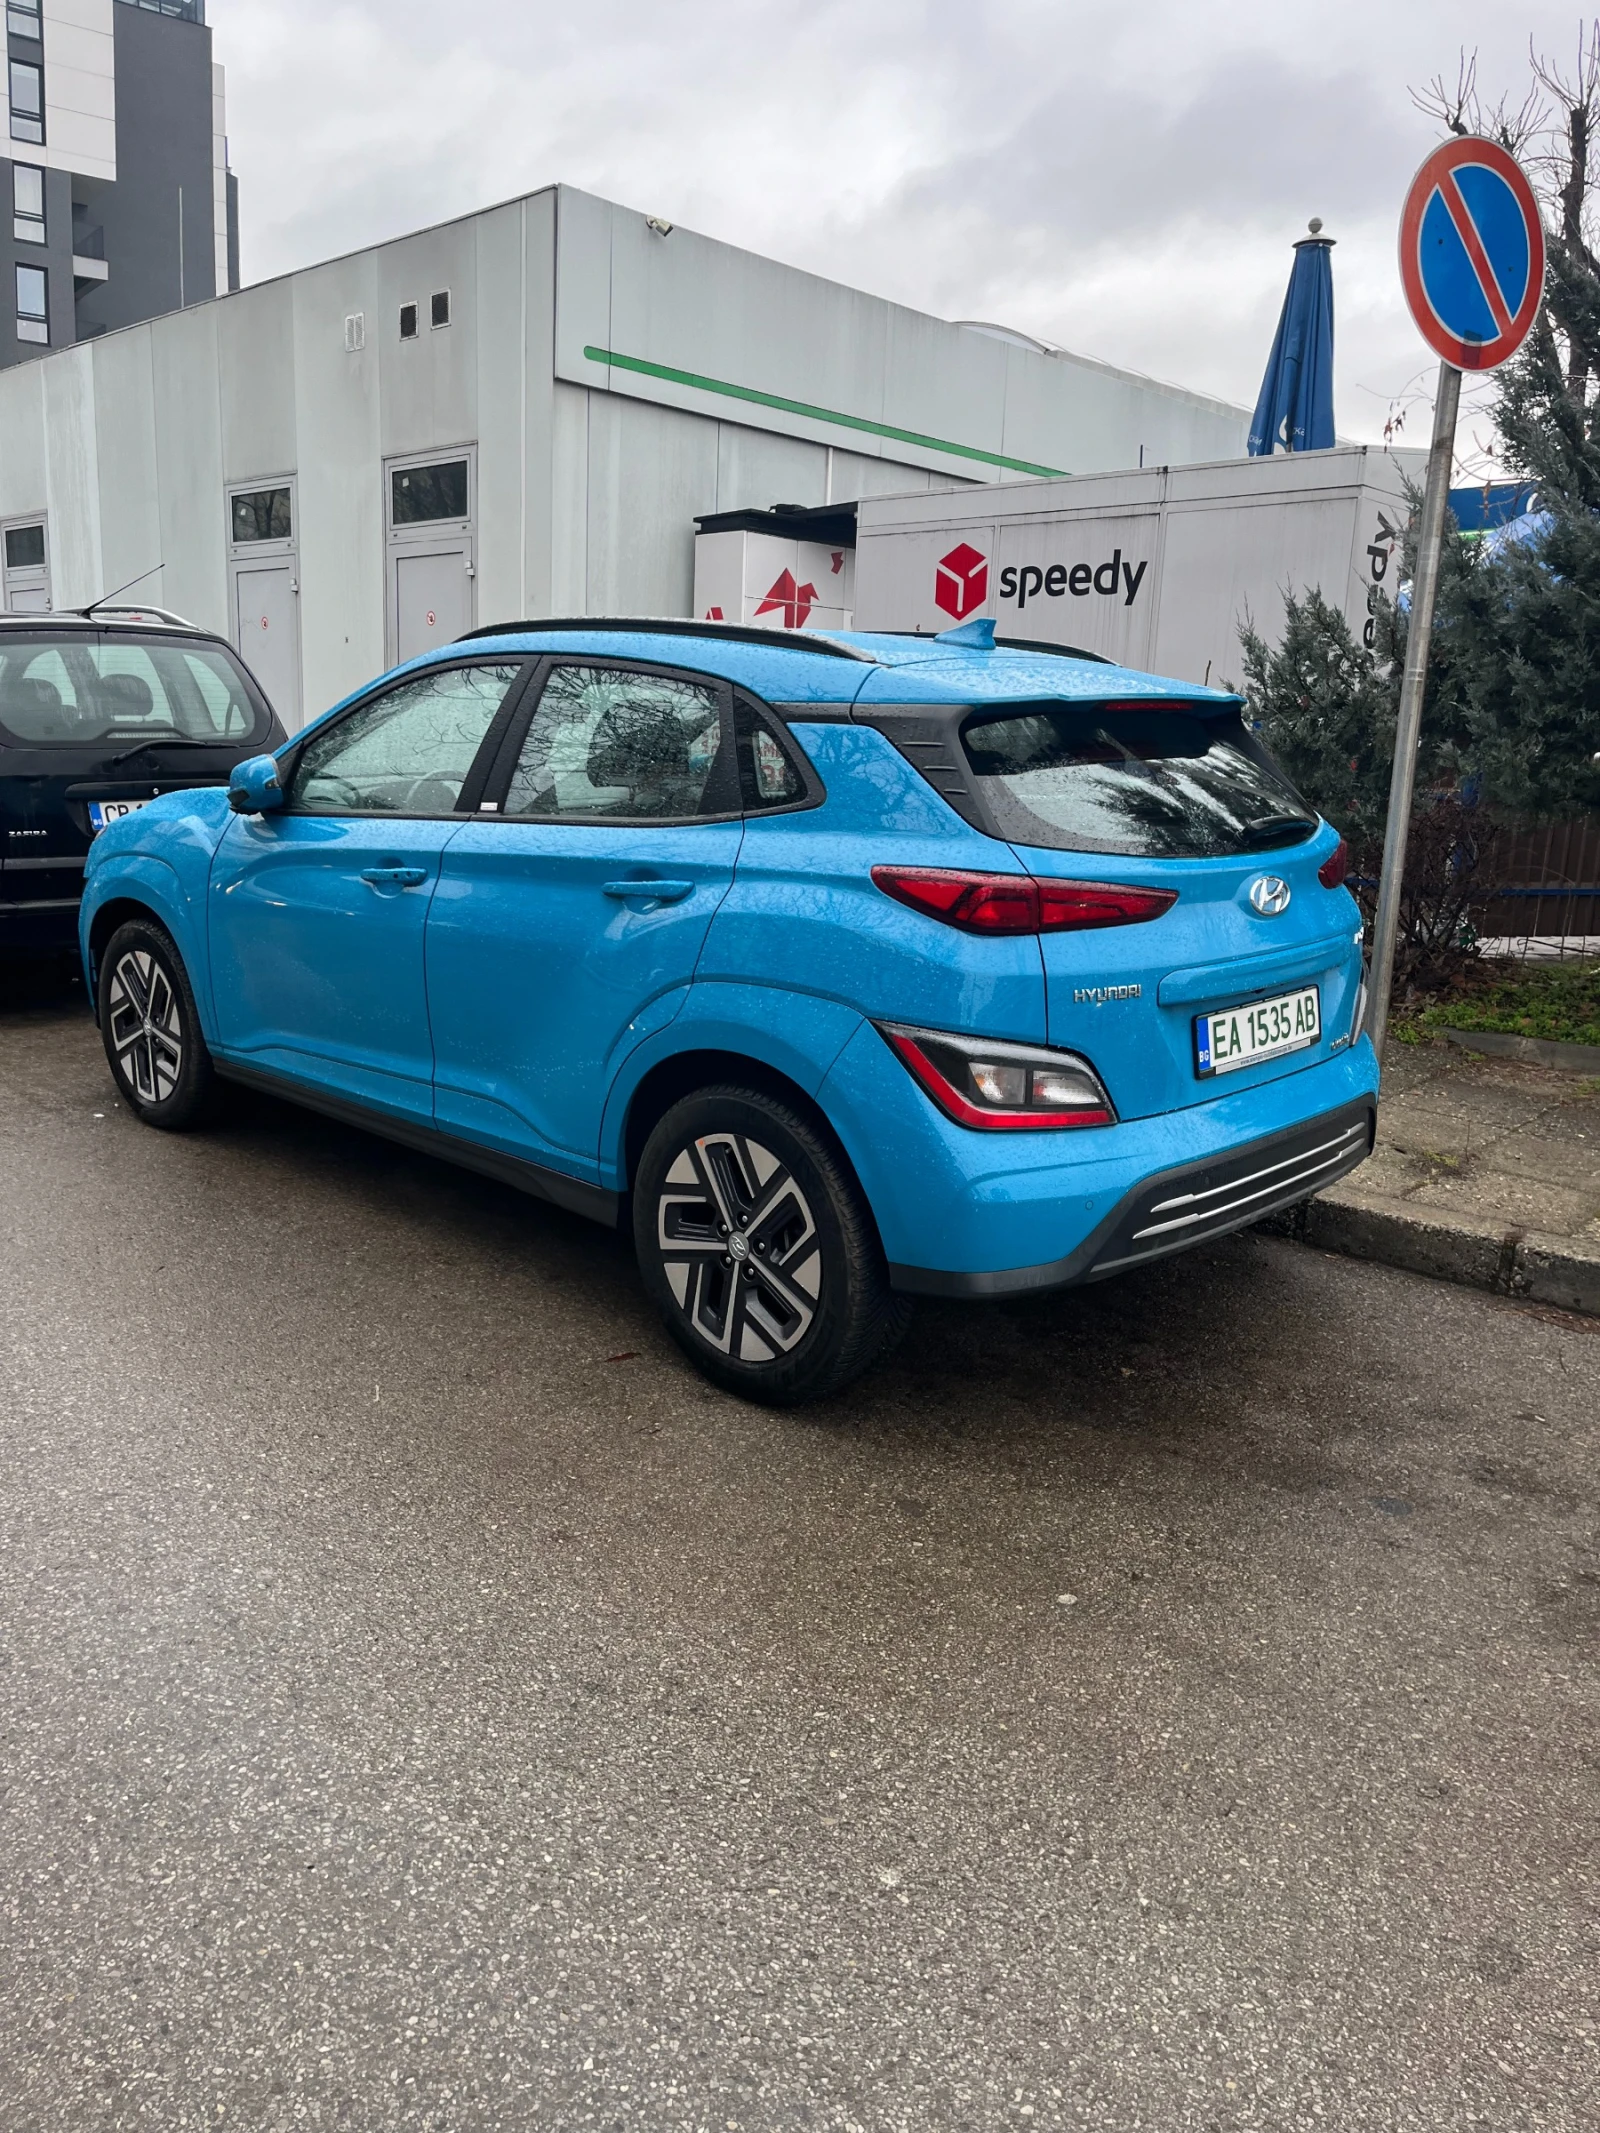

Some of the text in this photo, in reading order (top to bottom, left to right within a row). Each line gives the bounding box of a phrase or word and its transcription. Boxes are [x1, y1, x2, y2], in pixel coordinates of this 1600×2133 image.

[1000, 549, 1148, 608] speedy
[1074, 984, 1141, 1003] HYUNDAI
[1213, 1016, 1242, 1060] EA
[1247, 1002, 1291, 1049] 1535
[1295, 995, 1316, 1036] AB
[1199, 1049, 1210, 1063] BG
